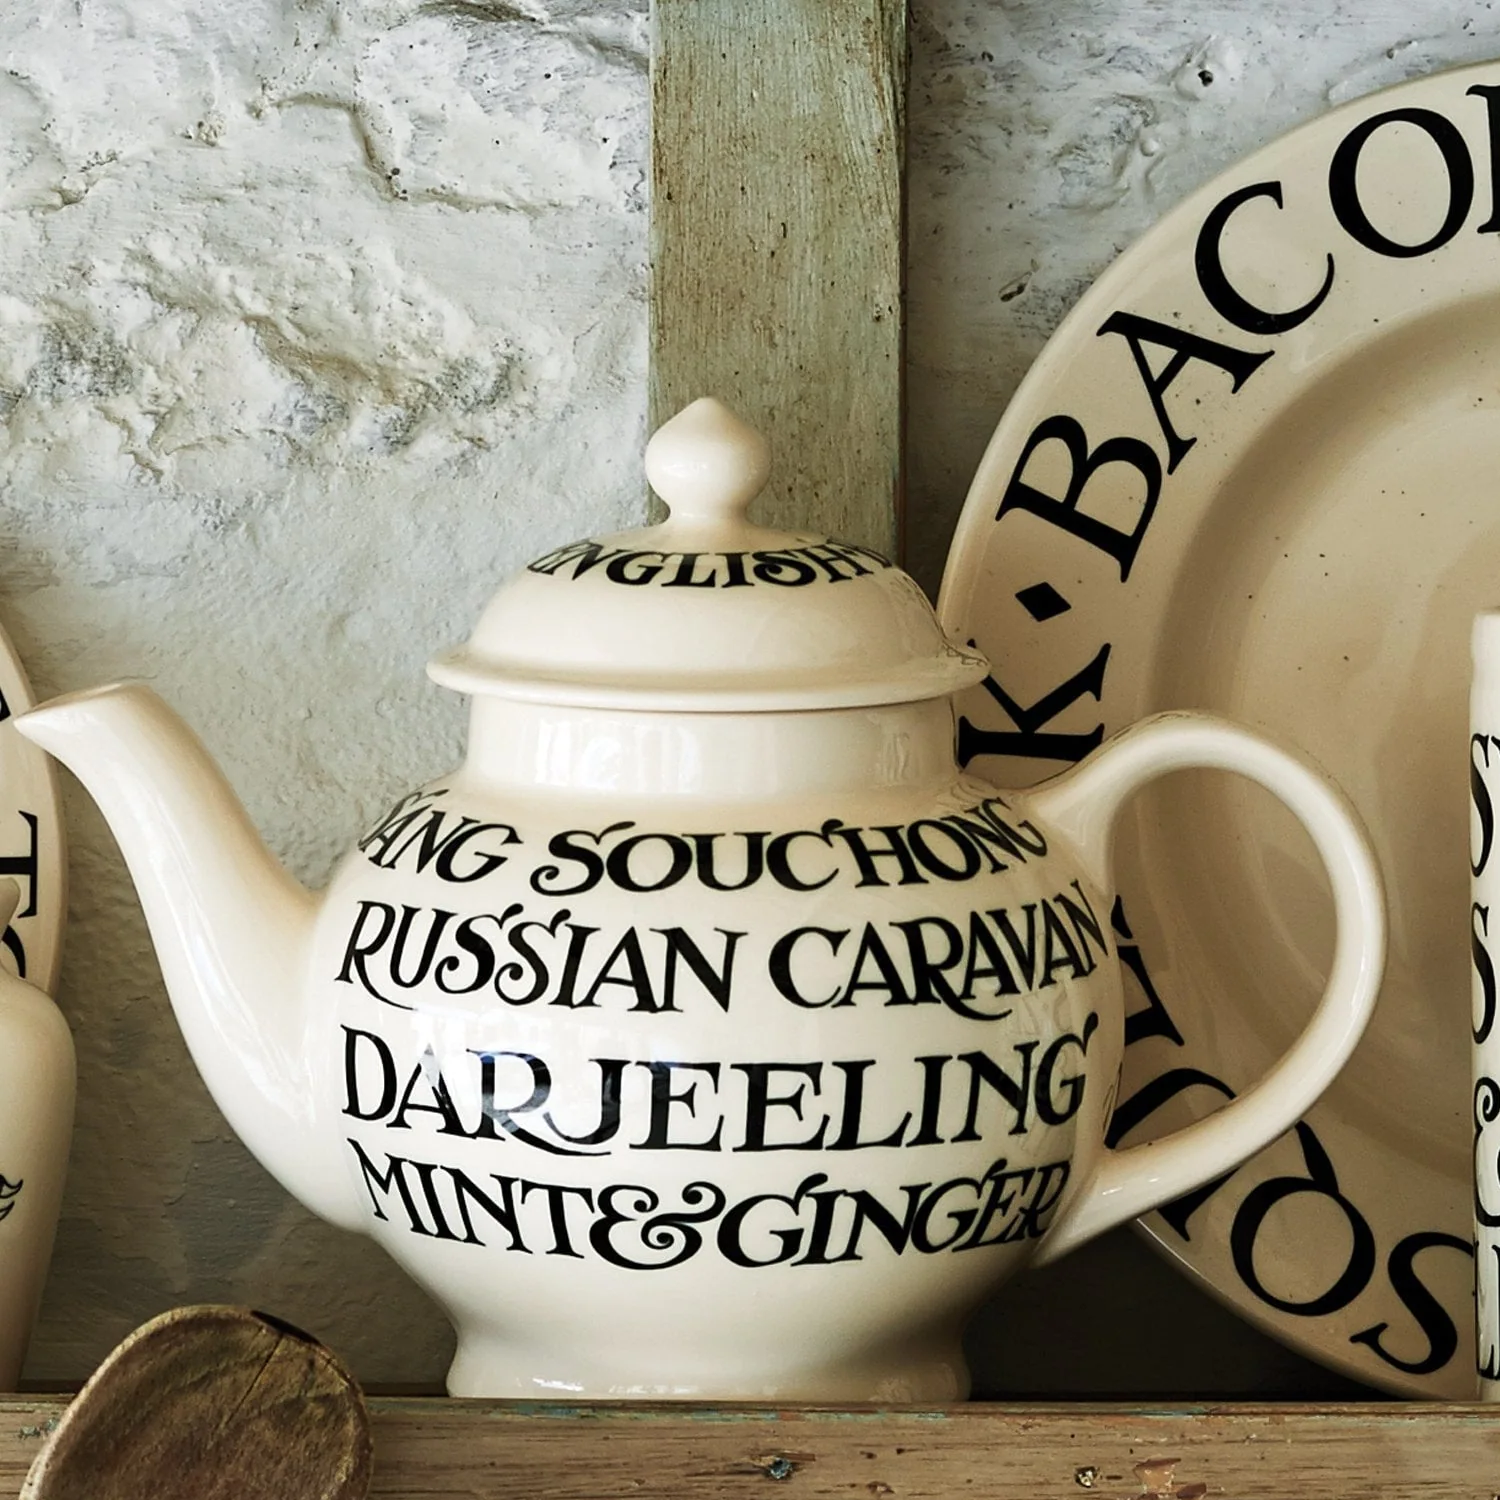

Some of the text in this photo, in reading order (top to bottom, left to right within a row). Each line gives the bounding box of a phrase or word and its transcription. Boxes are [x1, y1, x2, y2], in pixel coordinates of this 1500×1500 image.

[526, 538, 874, 588] ENGLISH
[530, 797, 1048, 896] SOUCHONG
[334, 878, 1111, 1021] RUSSIAN CARAVAN
[340, 1012, 1099, 1157] DARJEELING
